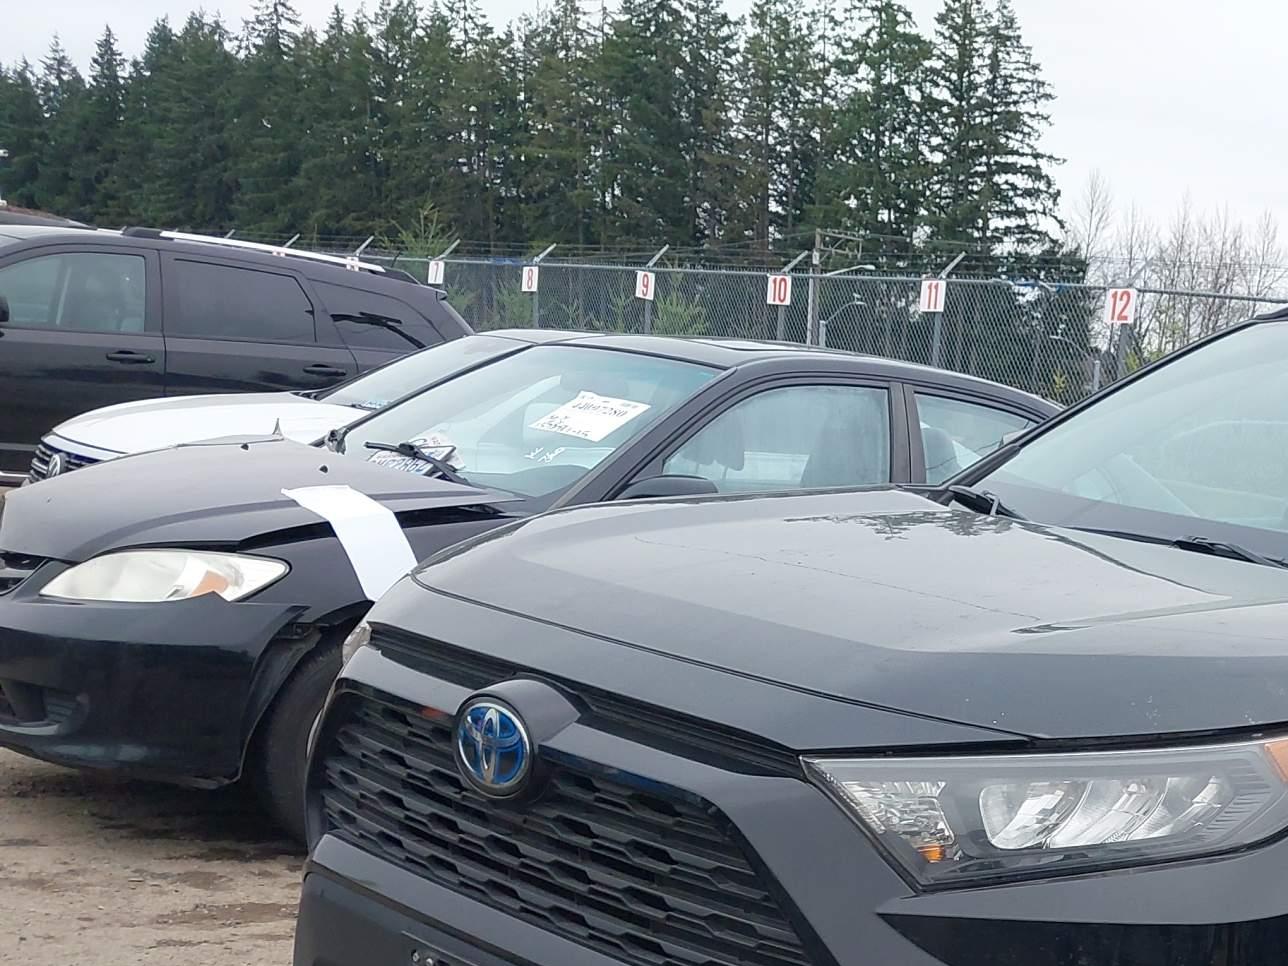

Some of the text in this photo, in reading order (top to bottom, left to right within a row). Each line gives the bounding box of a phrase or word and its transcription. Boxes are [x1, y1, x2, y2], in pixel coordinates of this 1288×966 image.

[432, 261, 441, 282] 7
[526, 267, 534, 290] 8
[640, 272, 650, 298] 9
[771, 276, 788, 304] 10
[925, 283, 941, 309] 11
[1109, 290, 1131, 322] 12
